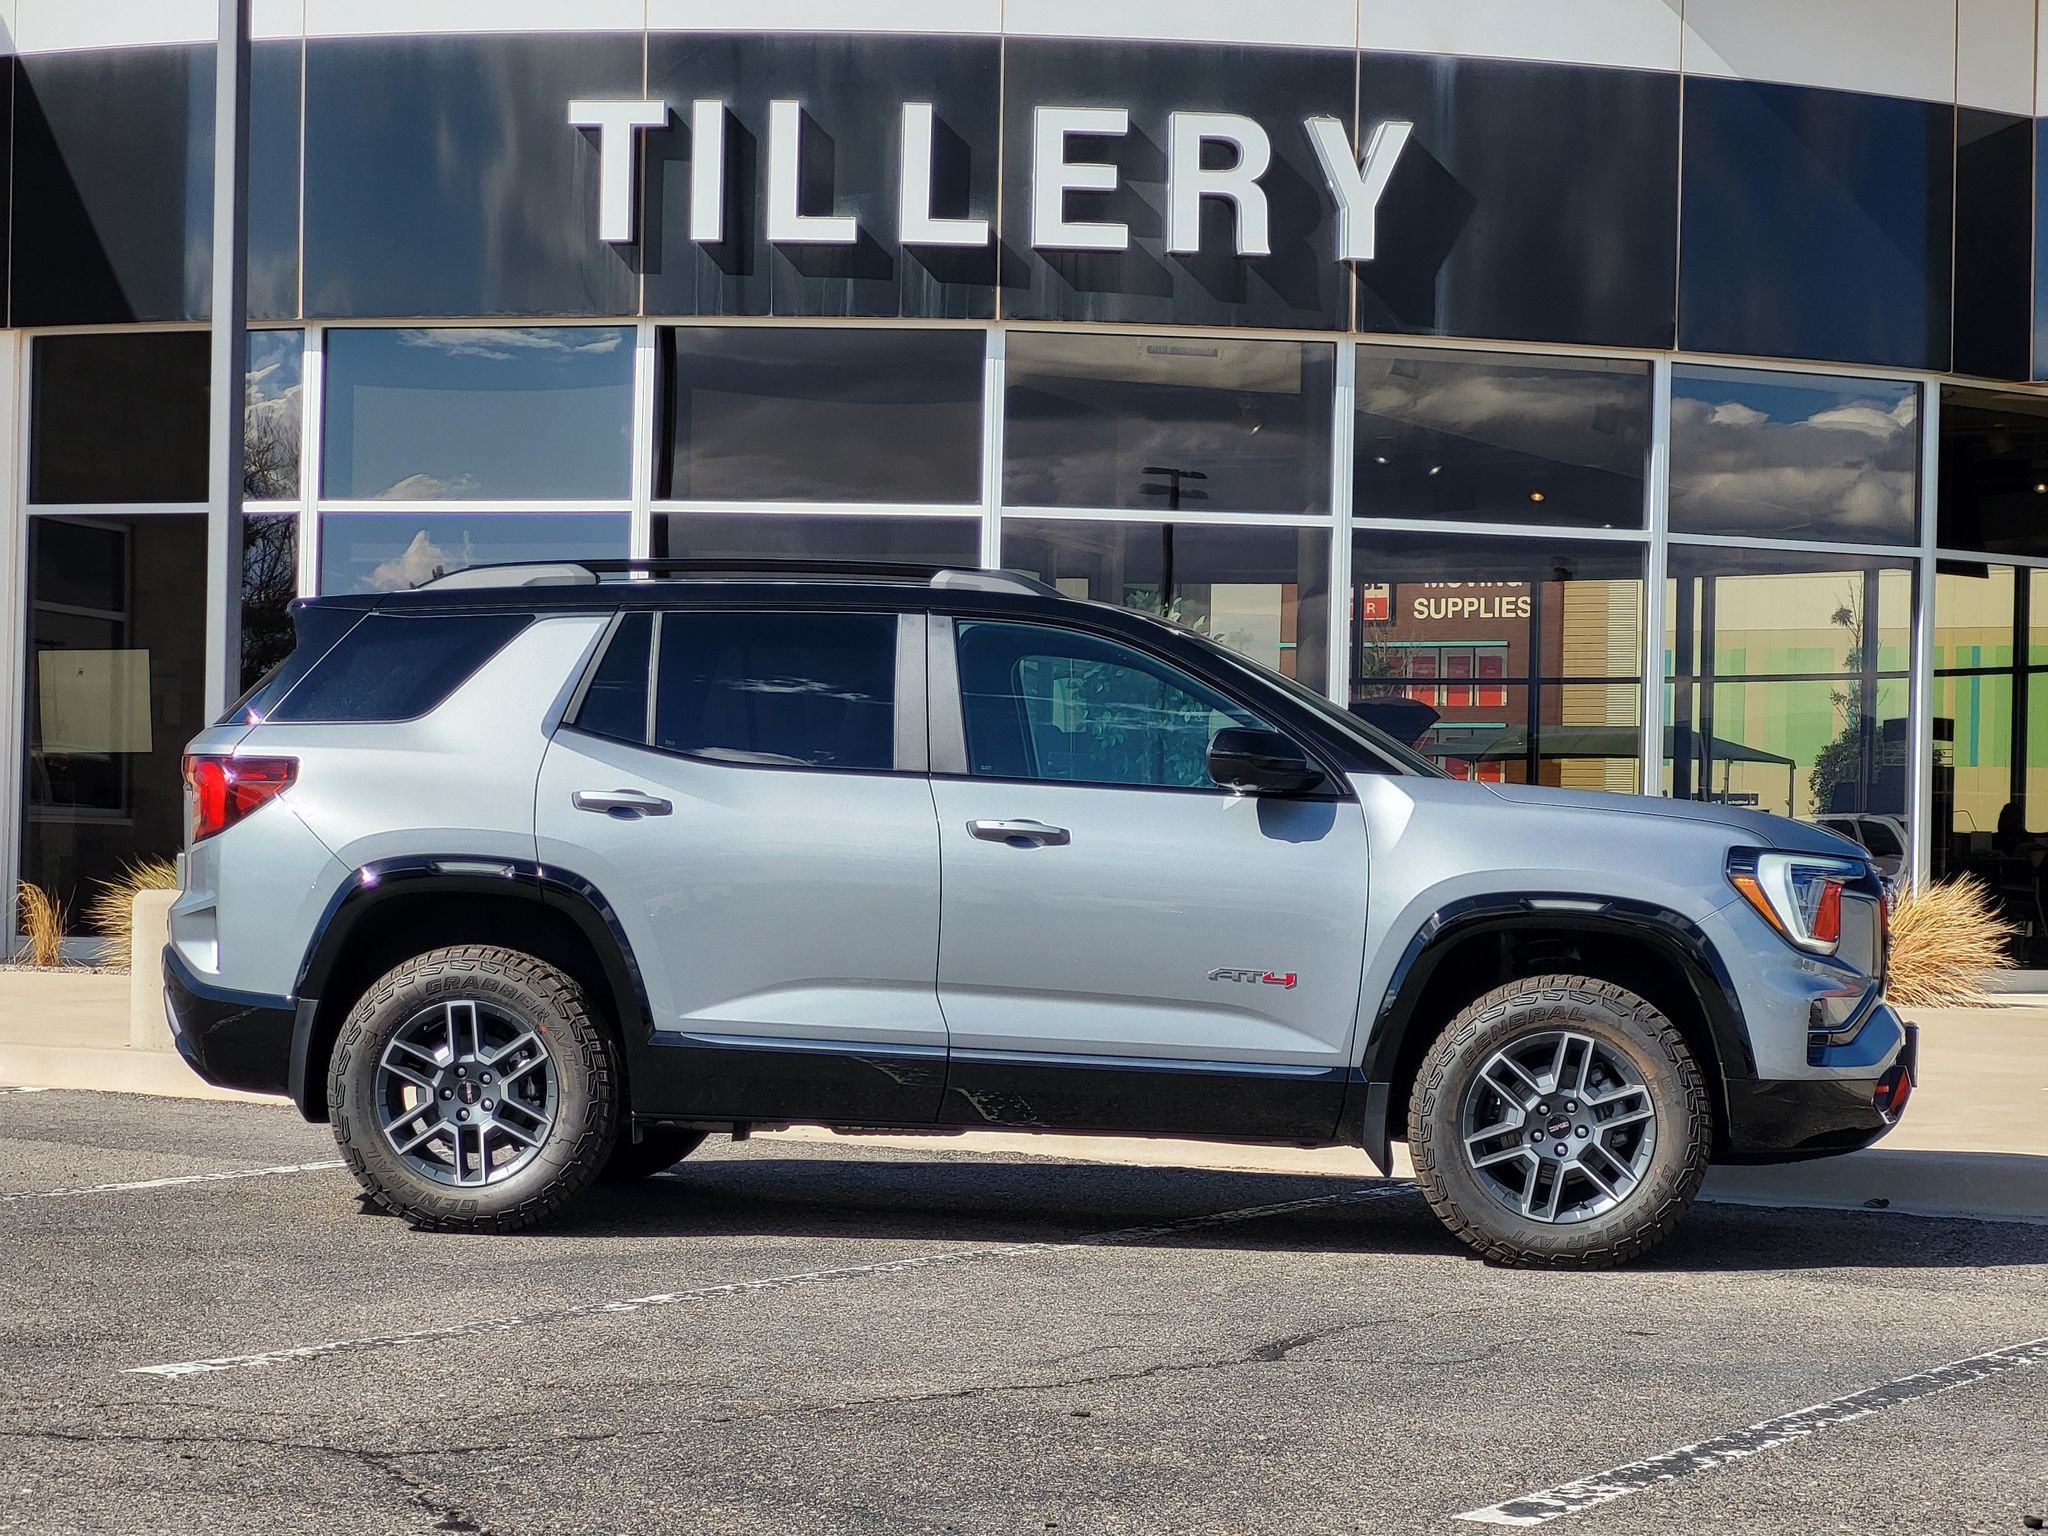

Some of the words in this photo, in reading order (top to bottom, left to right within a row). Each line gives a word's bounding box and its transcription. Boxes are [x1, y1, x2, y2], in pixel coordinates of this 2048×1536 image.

[567, 98, 1414, 263] TILLERY
[1413, 596, 1531, 619] SUPPLIES
[425, 975, 550, 1024] GRABBER
[1207, 966, 1298, 990] AT4
[1460, 1005, 1586, 1068] GENERAL
[366, 1141, 480, 1213] GENERAL
[1566, 1163, 1677, 1249] GRABBER
